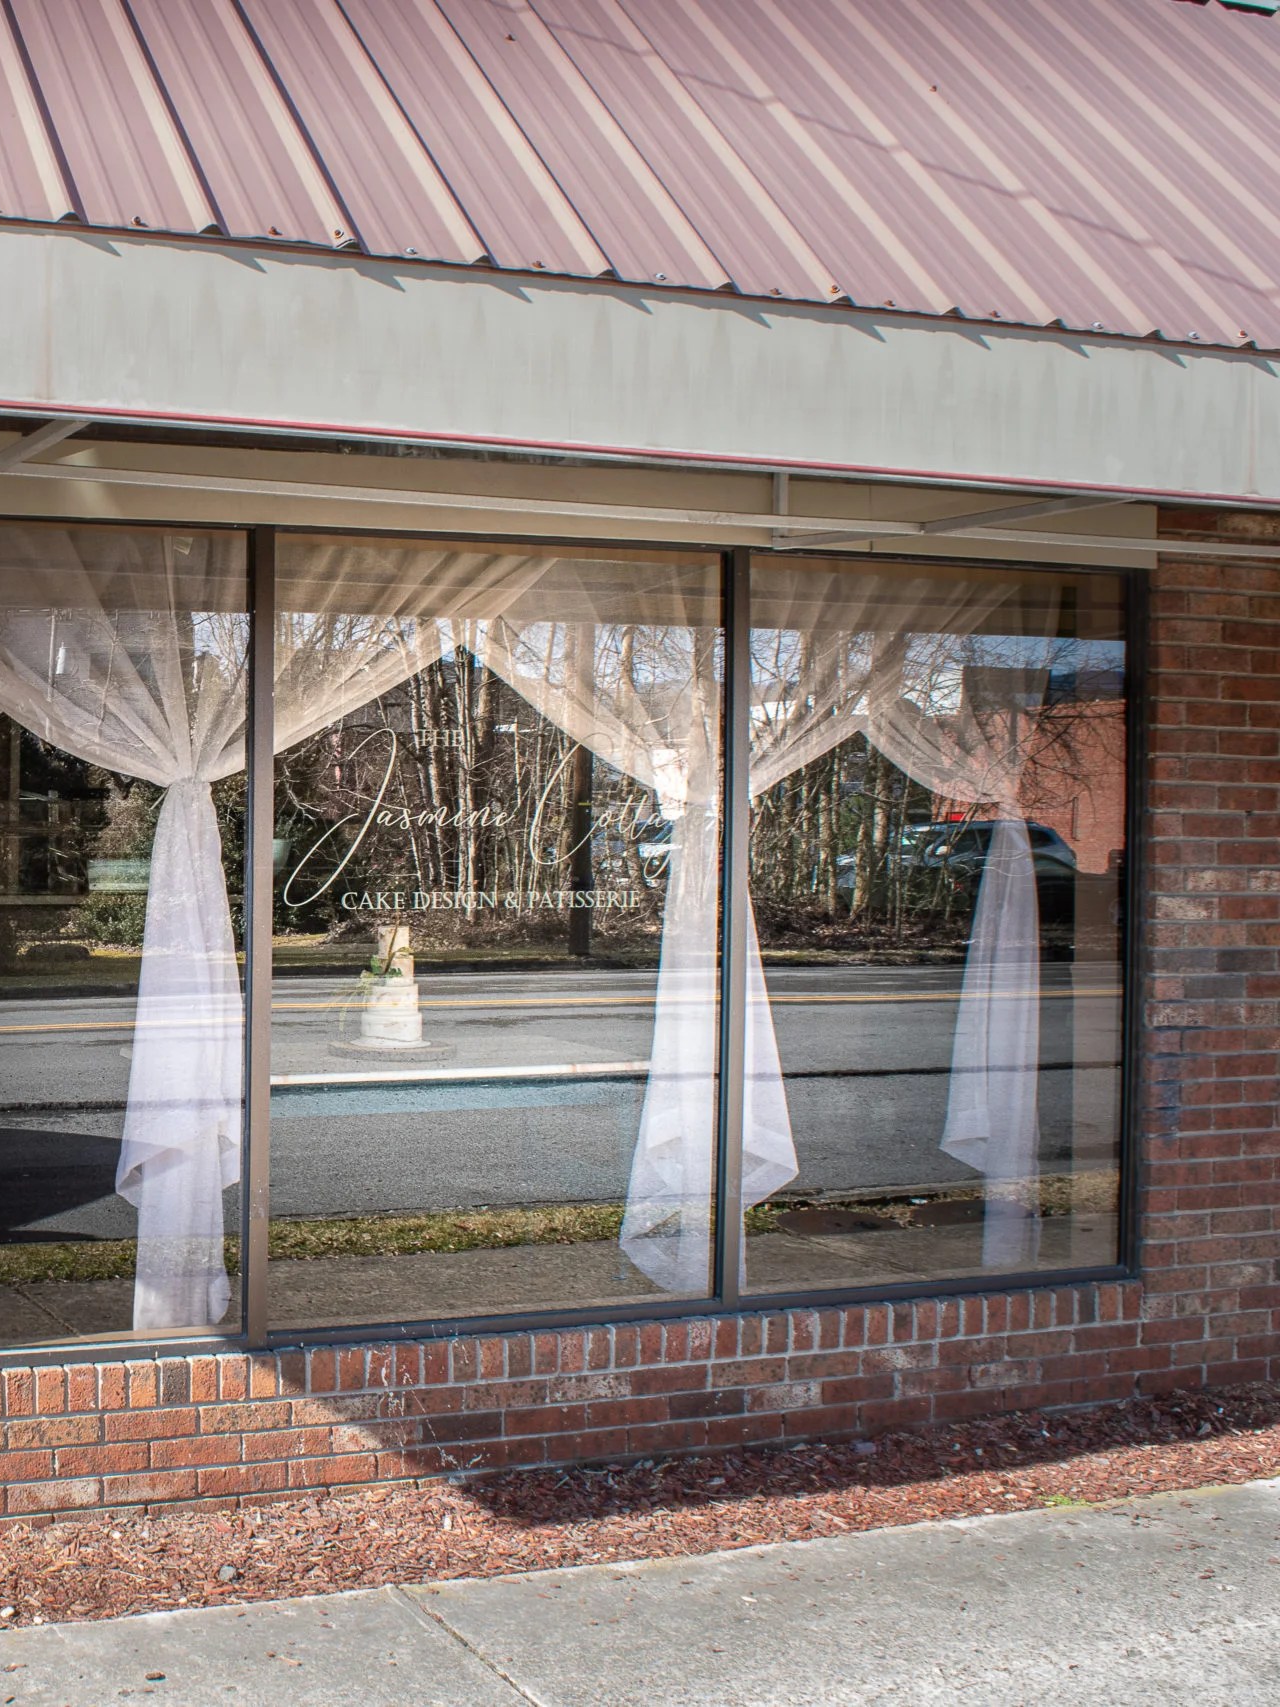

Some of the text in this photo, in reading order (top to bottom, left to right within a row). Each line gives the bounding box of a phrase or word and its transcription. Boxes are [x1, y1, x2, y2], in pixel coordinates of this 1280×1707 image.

[418, 729, 465, 748] THE
[284, 728, 513, 907] Jasmine
[341, 889, 641, 911] CAKE DESIGN & PATISSERIE
